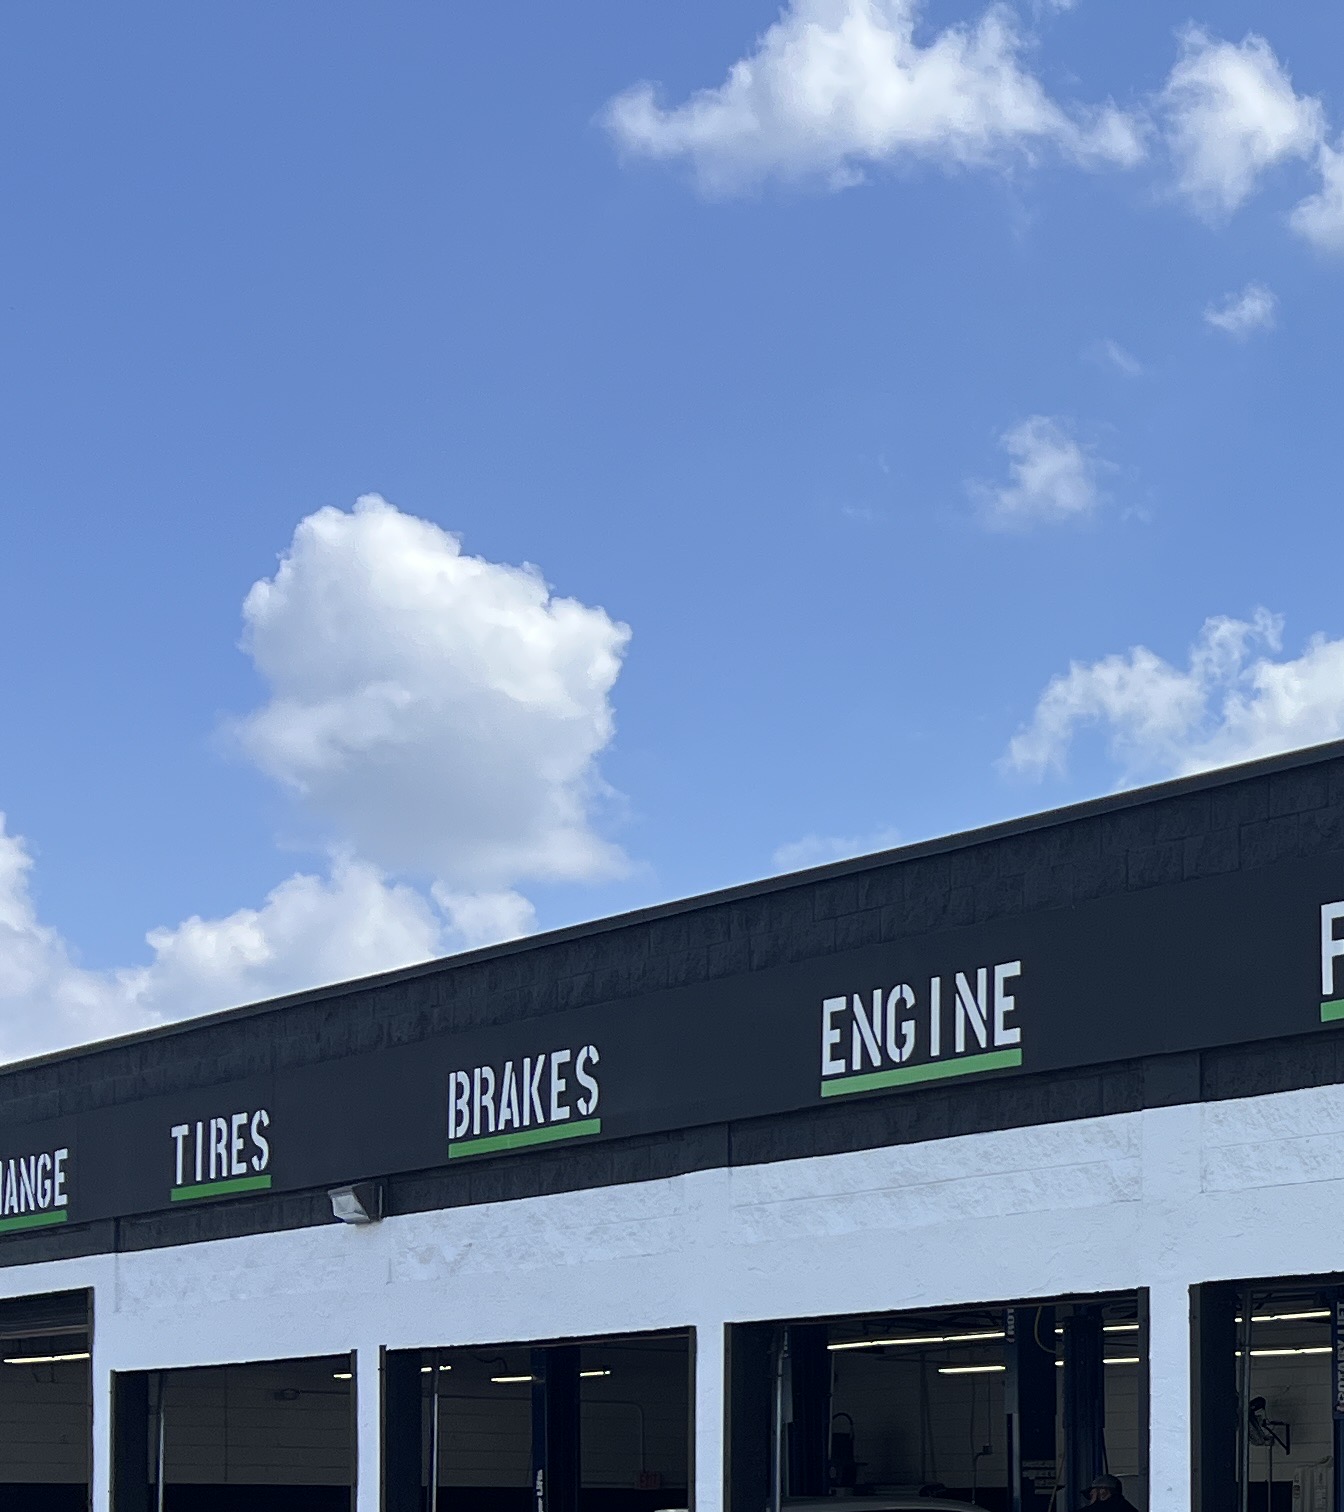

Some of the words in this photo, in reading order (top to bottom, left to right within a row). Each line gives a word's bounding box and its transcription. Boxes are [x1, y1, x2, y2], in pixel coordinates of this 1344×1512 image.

[822, 960, 1021, 1076] ENGINE
[448, 1044, 600, 1140] BRAKES
[171, 1108, 270, 1185] TIRES
